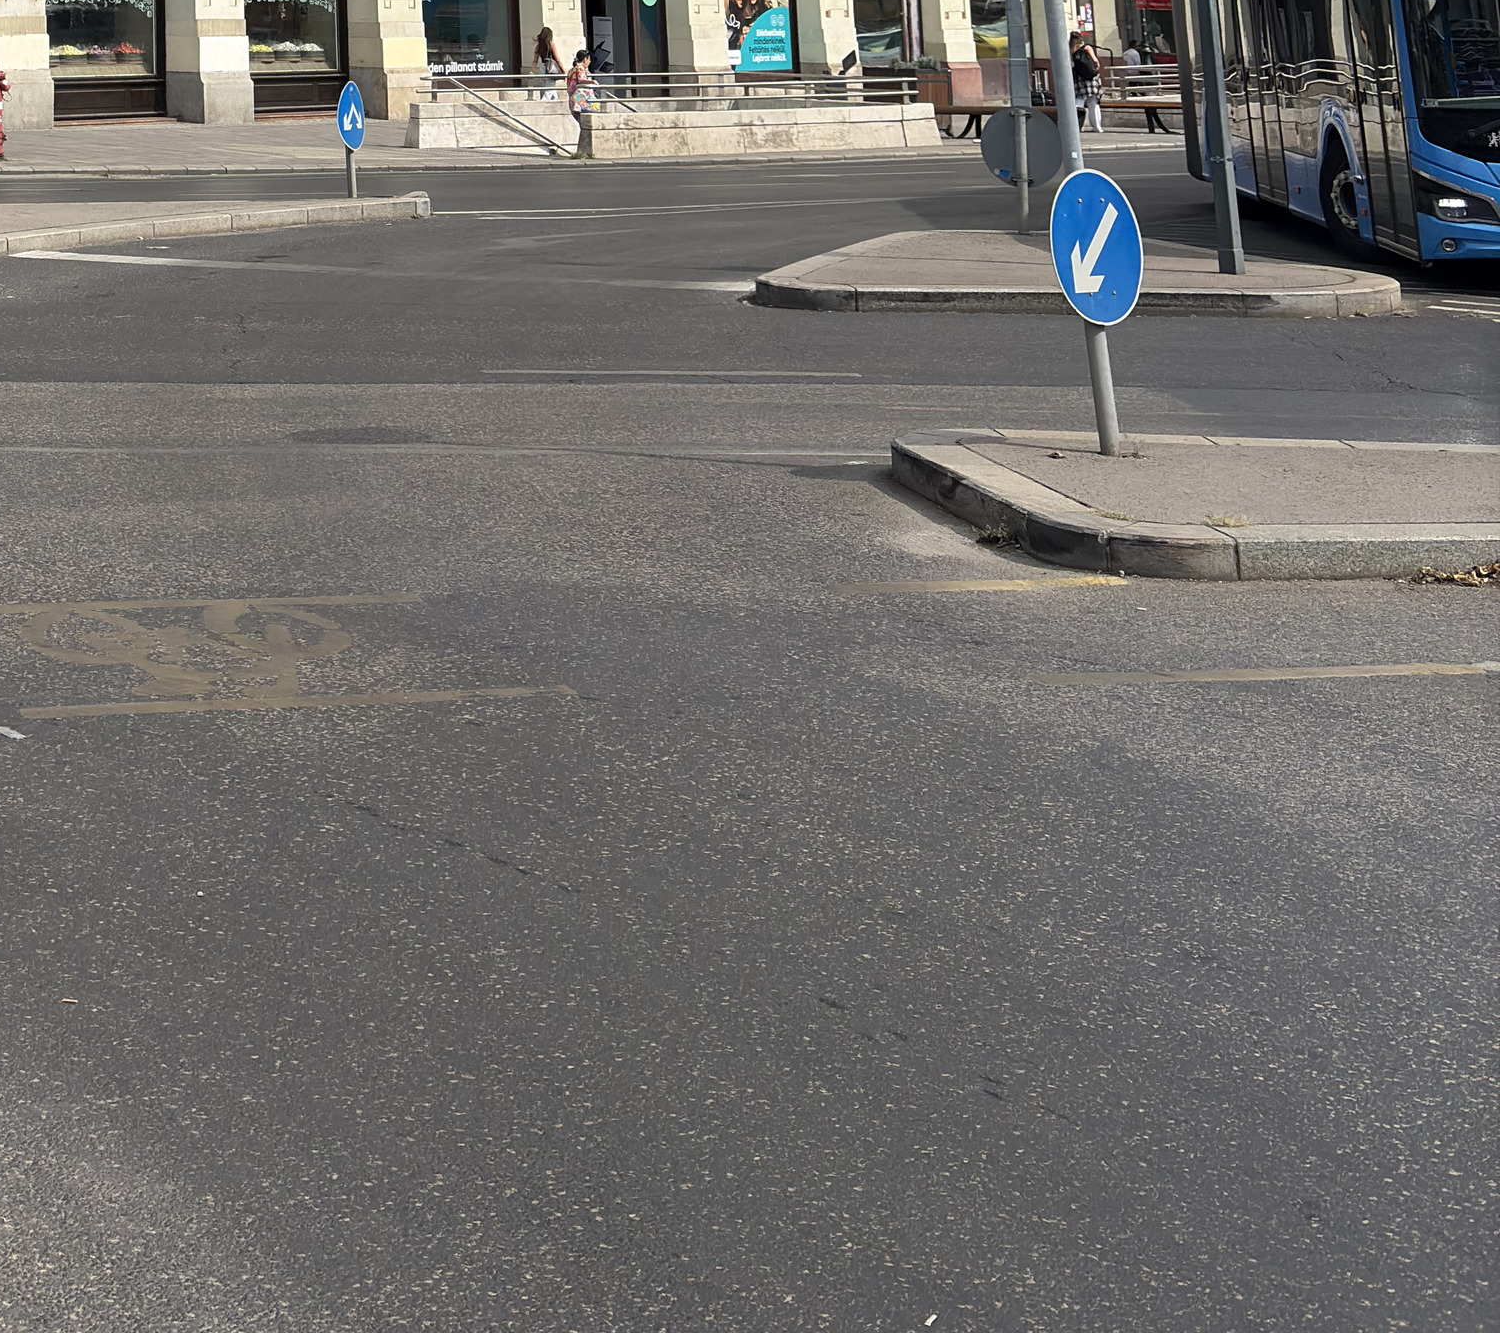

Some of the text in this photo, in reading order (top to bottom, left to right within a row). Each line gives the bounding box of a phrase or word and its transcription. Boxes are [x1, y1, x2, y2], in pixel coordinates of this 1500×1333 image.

[428, 60, 504, 75] den pillanat számít
